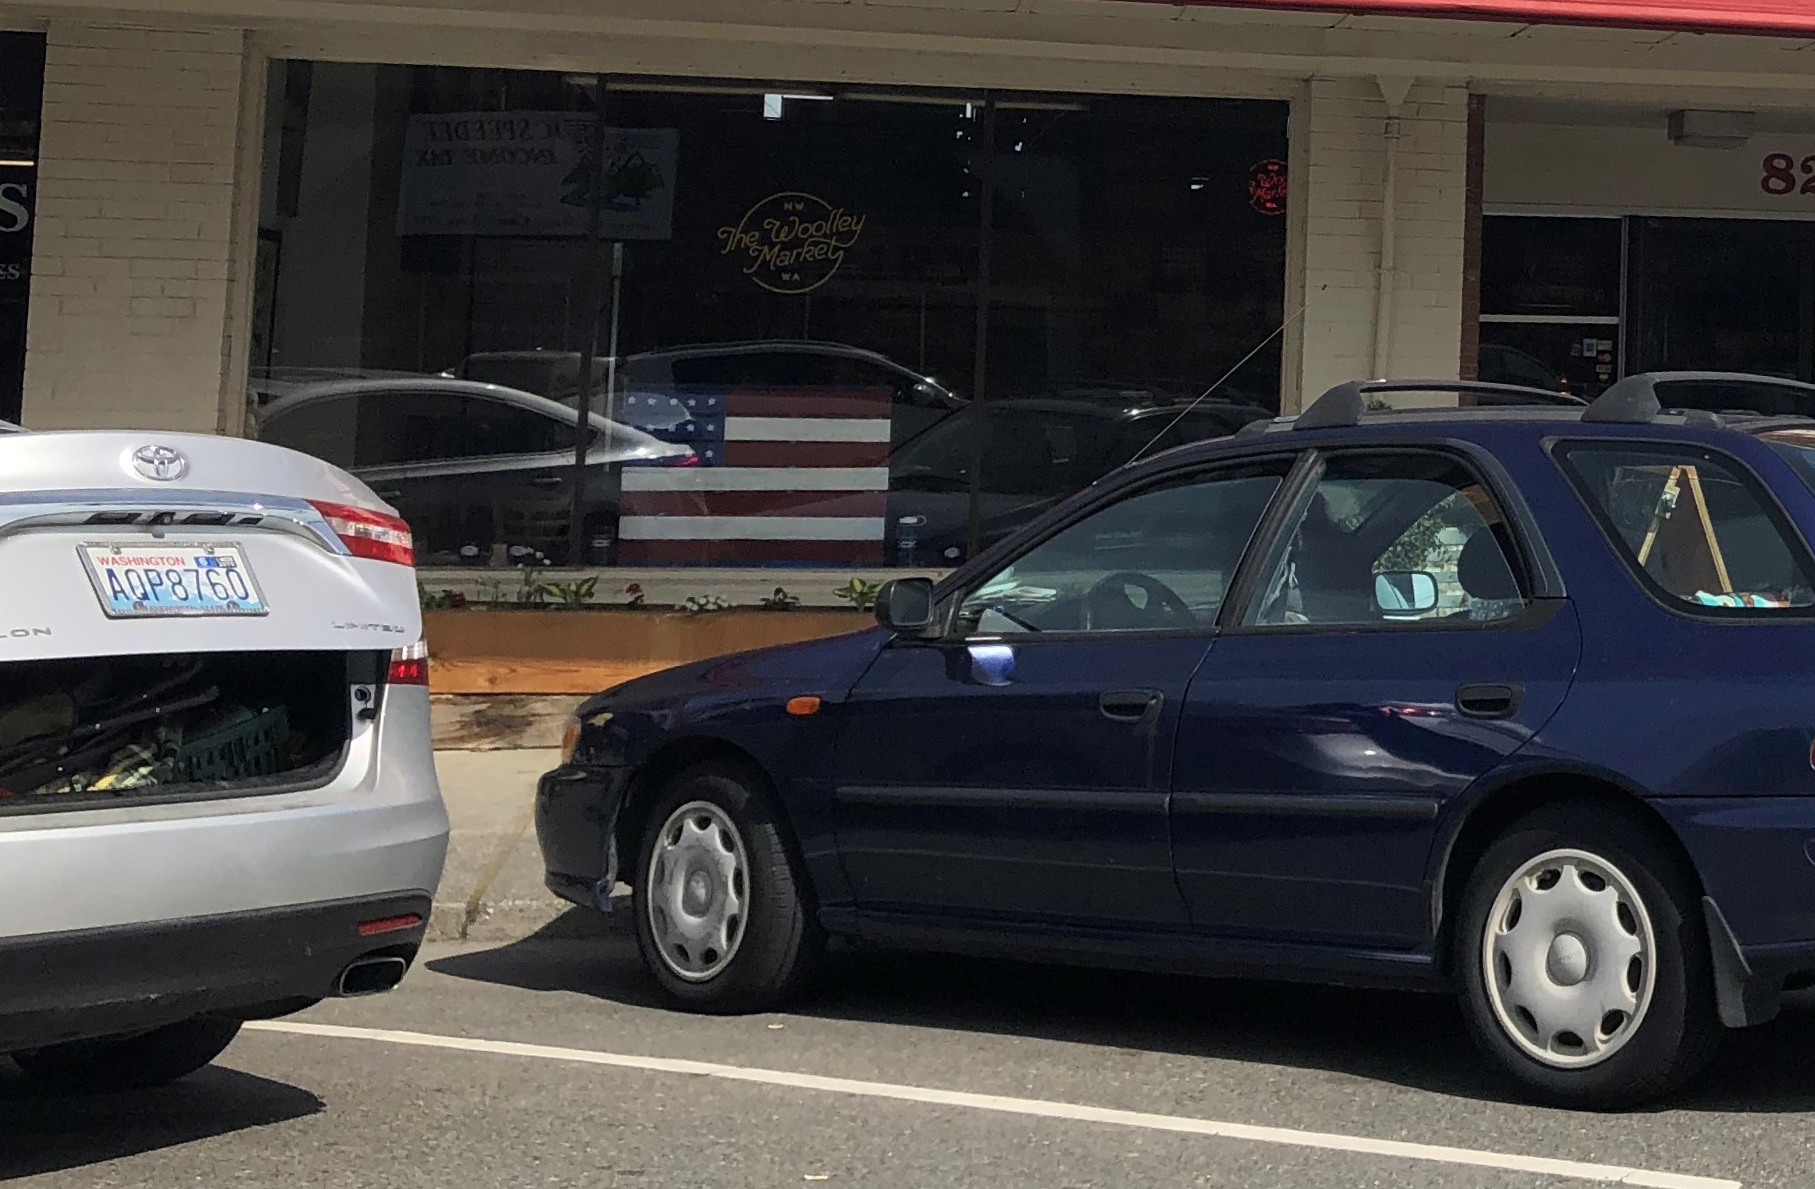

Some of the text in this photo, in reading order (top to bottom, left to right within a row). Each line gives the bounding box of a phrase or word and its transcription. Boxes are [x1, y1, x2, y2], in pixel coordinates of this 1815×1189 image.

[717, 208, 866, 254] The Woolley
[743, 236, 844, 273] Market
[97, 555, 186, 567] WASHINGTON
[106, 568, 250, 602] AQP8760
